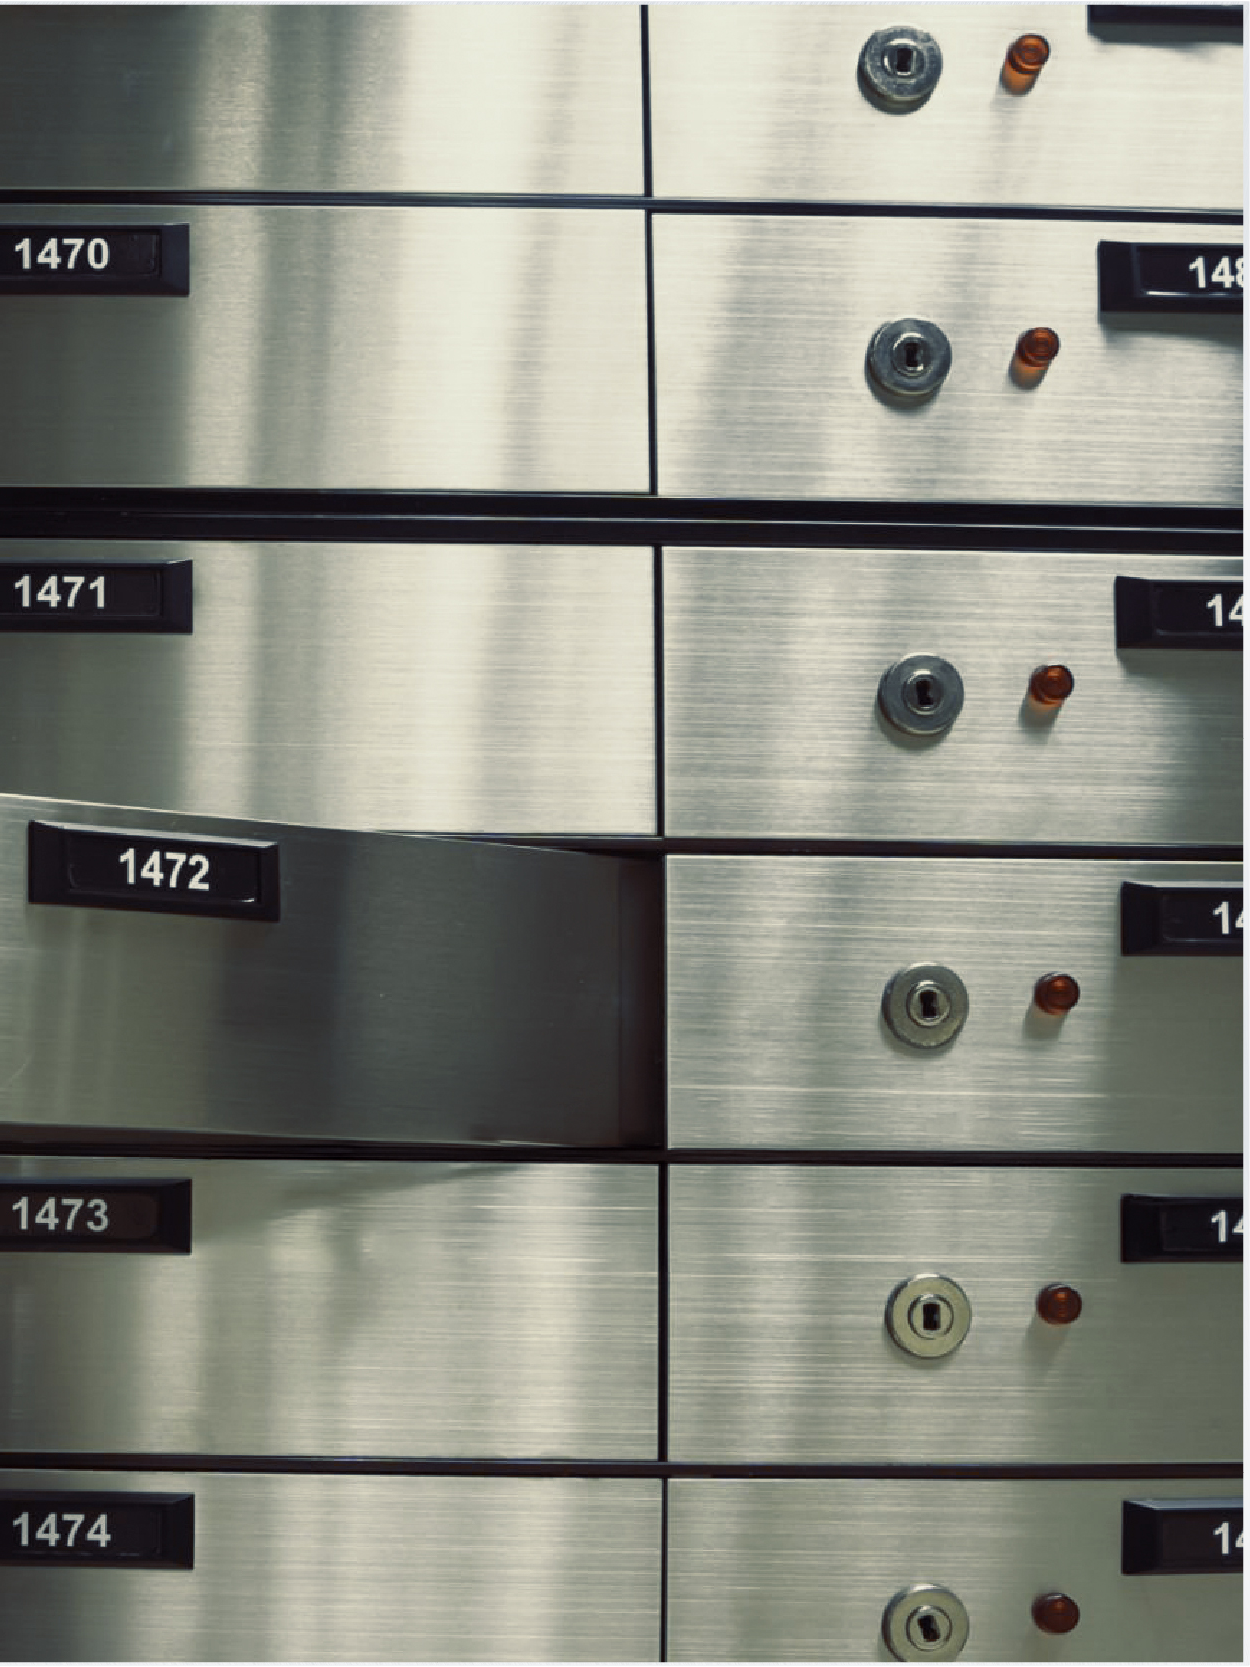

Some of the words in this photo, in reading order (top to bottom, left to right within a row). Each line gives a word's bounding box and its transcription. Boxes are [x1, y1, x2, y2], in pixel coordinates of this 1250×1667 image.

[14, 237, 110, 270] 1470
[14, 575, 105, 608] 1471
[119, 847, 210, 892] 1472
[12, 1196, 109, 1231] 1473
[12, 1511, 112, 1547] 1474
